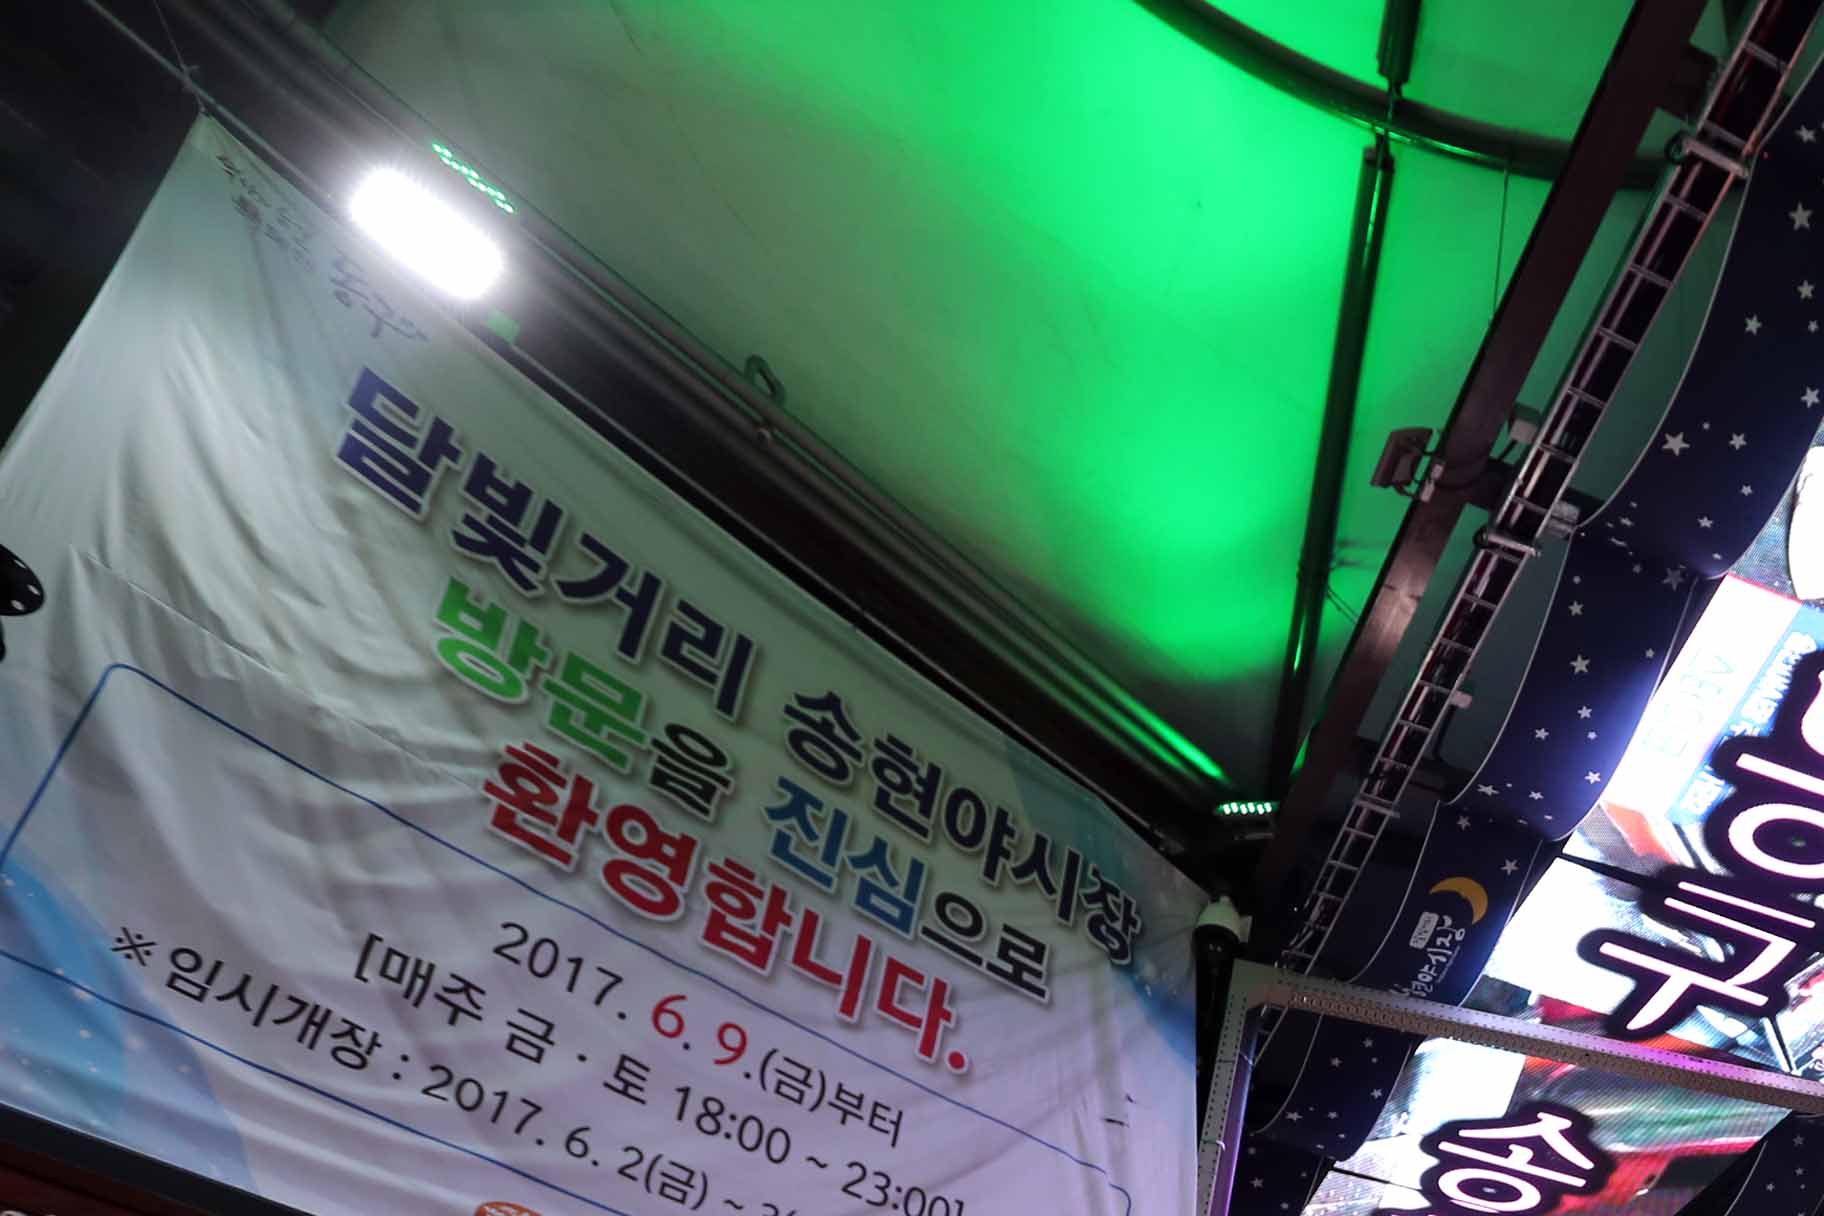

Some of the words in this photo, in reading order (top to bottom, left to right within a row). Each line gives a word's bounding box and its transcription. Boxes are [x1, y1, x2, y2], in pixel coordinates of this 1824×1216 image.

[335, 366, 757, 718] 달빛거리
[783, 690, 1143, 965] 송현야시장
[434, 576, 734, 819] 방문을
[764, 774, 1050, 1002] 진심으로
[353, 932, 488, 1028] [매주
[672, 1084, 792, 1166] 18:00
[481, 739, 973, 1075] 환영합니다.
[492, 920, 628, 1020] 2017.
[419, 1063, 546, 1147] 2017.
[616, 1144, 710, 1213] 2(금)
